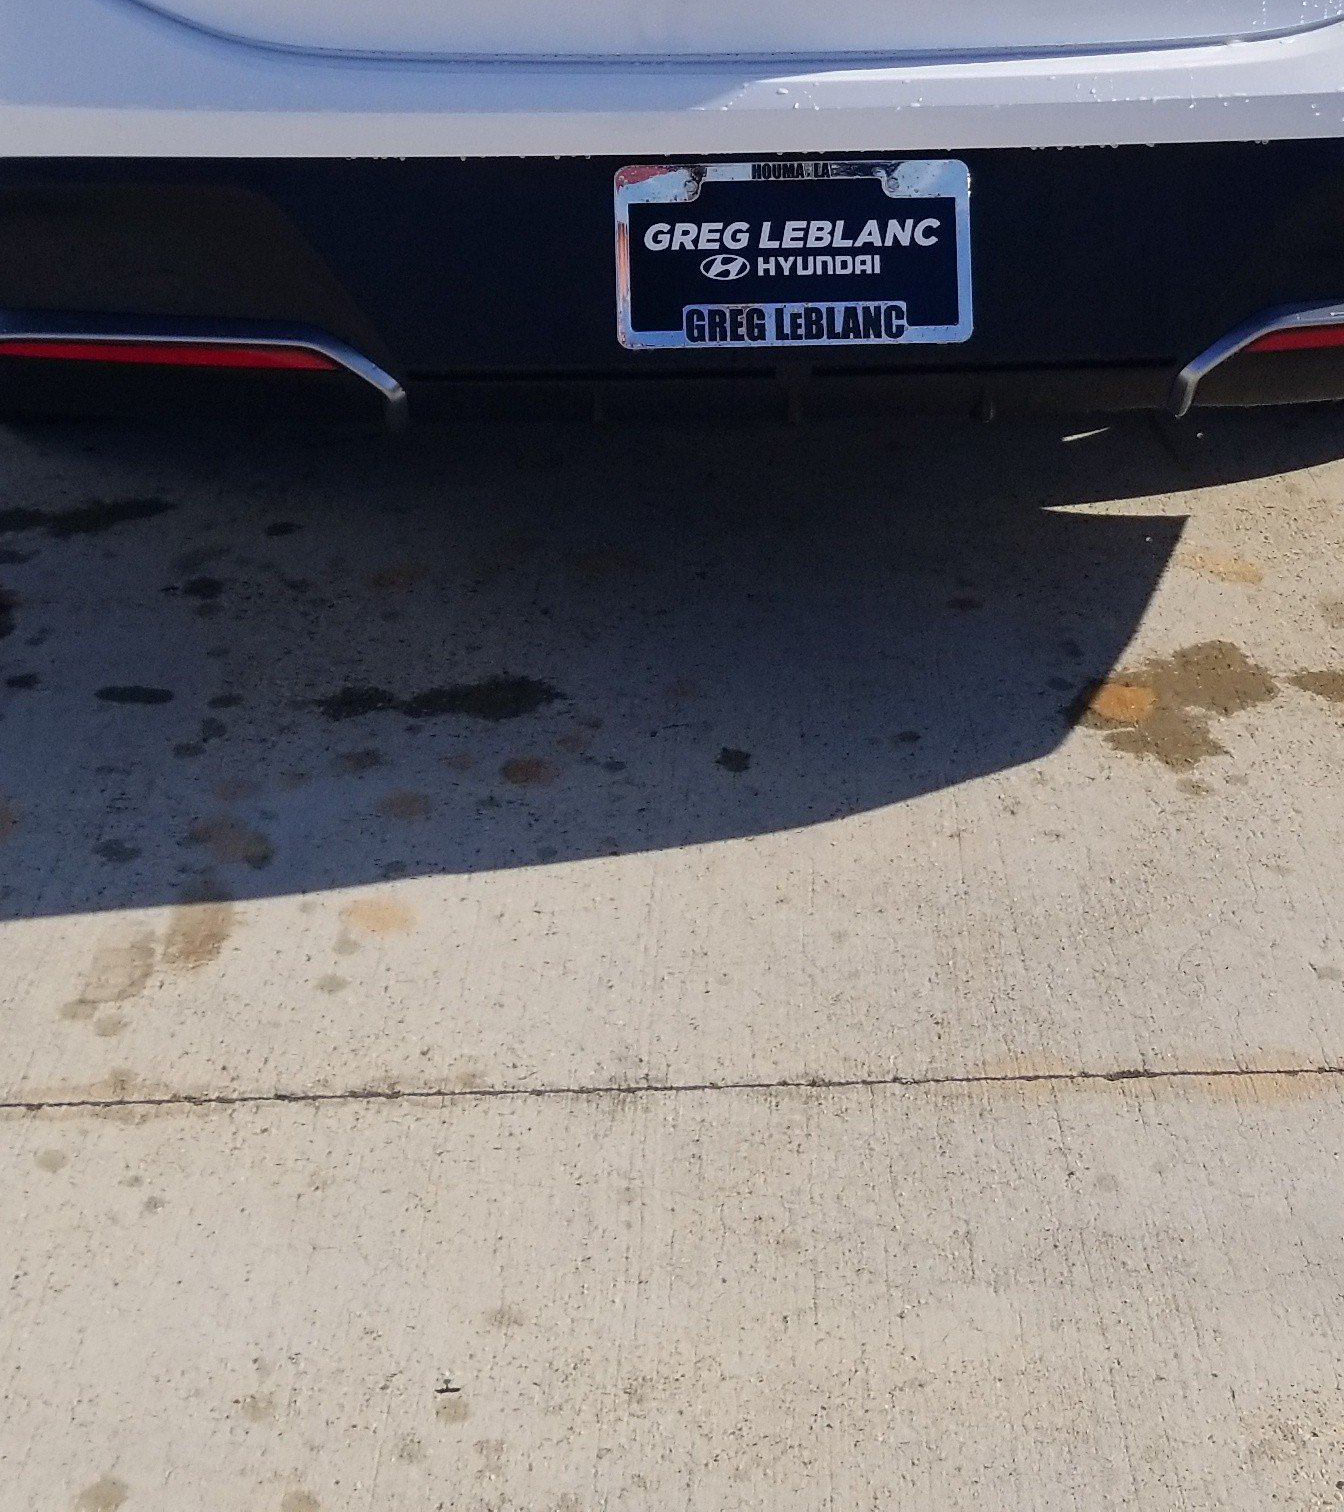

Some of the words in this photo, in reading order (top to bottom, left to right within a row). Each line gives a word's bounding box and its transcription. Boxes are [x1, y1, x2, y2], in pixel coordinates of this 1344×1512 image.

[813, 162, 831, 178] LA
[644, 221, 750, 251] GREG
[758, 218, 941, 249] LEBLANC
[757, 254, 881, 276] HYUNDAI
[685, 308, 767, 343] GREG
